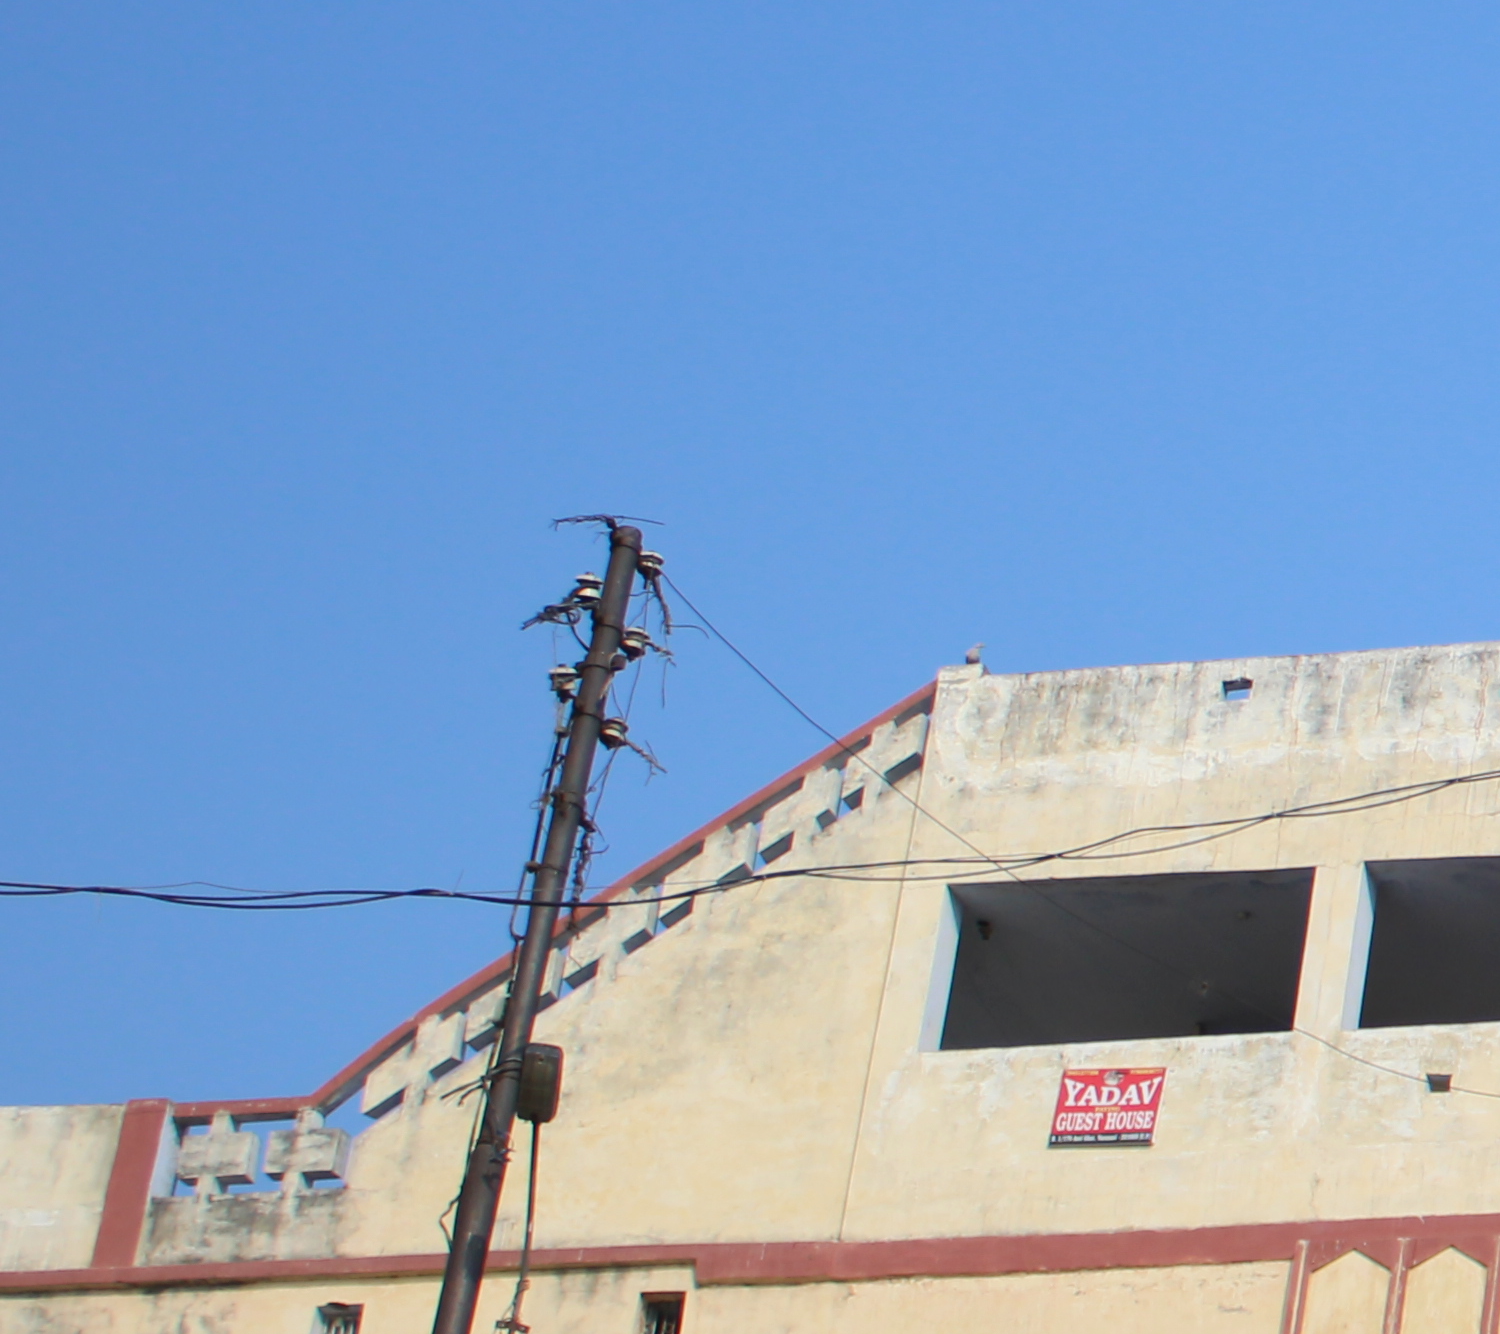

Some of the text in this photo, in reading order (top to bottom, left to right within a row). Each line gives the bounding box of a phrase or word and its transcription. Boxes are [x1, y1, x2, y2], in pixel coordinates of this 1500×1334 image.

[1064, 1076, 1162, 1106] YADAV
[1056, 1110, 1154, 1131] GUEST HOUSE
